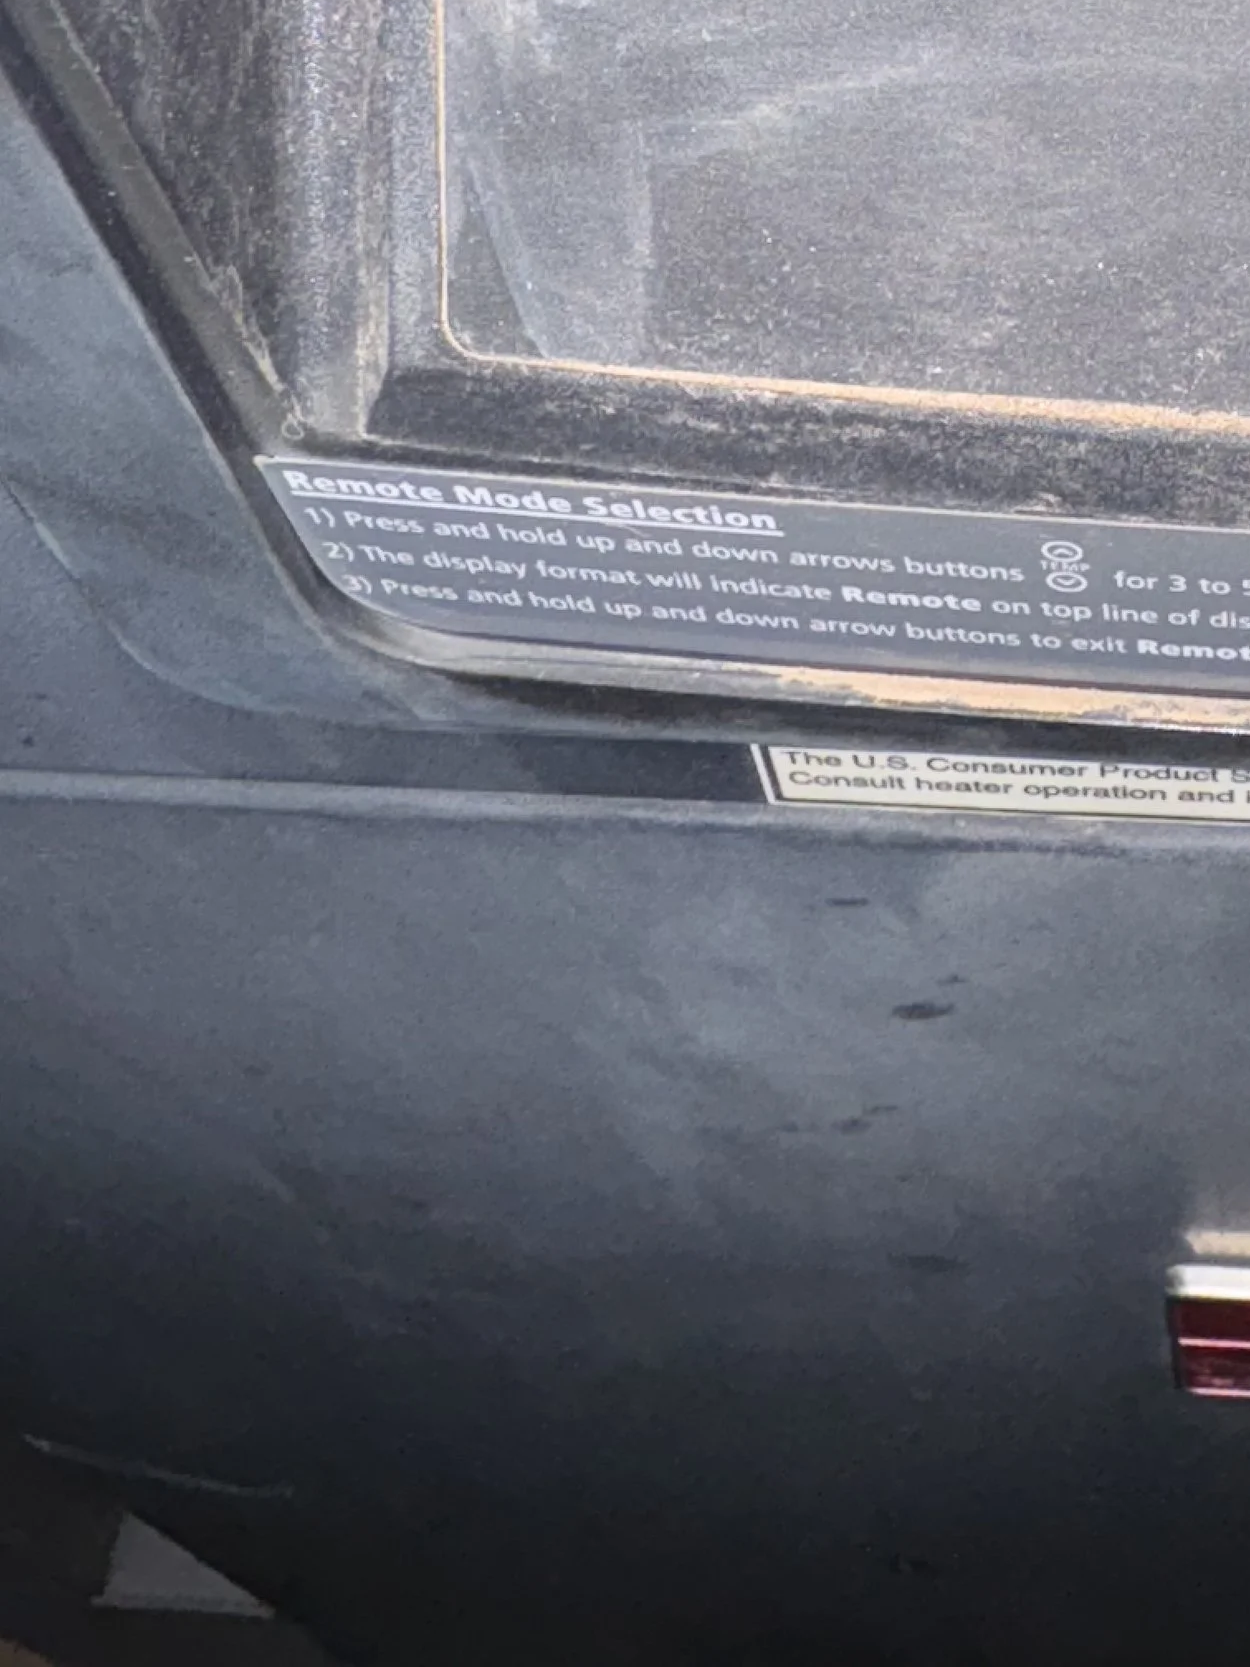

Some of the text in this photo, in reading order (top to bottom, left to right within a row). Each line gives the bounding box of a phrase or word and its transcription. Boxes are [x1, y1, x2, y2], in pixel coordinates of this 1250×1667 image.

[282, 470, 777, 529] Remote Mode Selection
[304, 507, 336, 528] 1)
[343, 510, 425, 534] Press
[433, 521, 490, 540] and
[498, 523, 567, 546] hold
[576, 535, 616, 554] up
[624, 539, 683, 556] and
[692, 541, 779, 564] down
[789, 551, 896, 573] arrows
[903, 556, 1026, 582] buttons
[1113, 570, 1159, 590] for
[1168, 574, 1187, 593] 3
[1198, 577, 1231, 595] to
[321, 542, 354, 562] 2)
[358, 545, 414, 566] The
[423, 550, 526, 579] display
[536, 560, 642, 585] format
[646, 571, 703, 591] will
[710, 575, 832, 600] indicate
[841, 585, 982, 612] Remote
[992, 600, 1031, 615] on
[1040, 602, 1093, 622] top
[1102, 602, 1159, 624] line
[1168, 608, 1200, 626] of
[341, 574, 372, 595] 3)
[381, 578, 459, 602] Press
[467, 588, 523, 608] and
[529, 591, 596, 613] hold
[603, 602, 643, 620] up
[652, 605, 707, 623] and
[715, 608, 800, 630] down
[810, 616, 896, 637] arrow
[905, 622, 1021, 647] buttons
[1030, 633, 1061, 649] to
[1071, 636, 1127, 654] exit
[786, 751, 842, 767] The
[852, 754, 917, 771] U.S.
[926, 757, 1088, 777] Consumer
[1099, 765, 1218, 783] Product
[788, 770, 906, 790] Consult
[915, 776, 1013, 794] heater
[1024, 783, 1167, 801] operation
[1177, 788, 1234, 804] and
